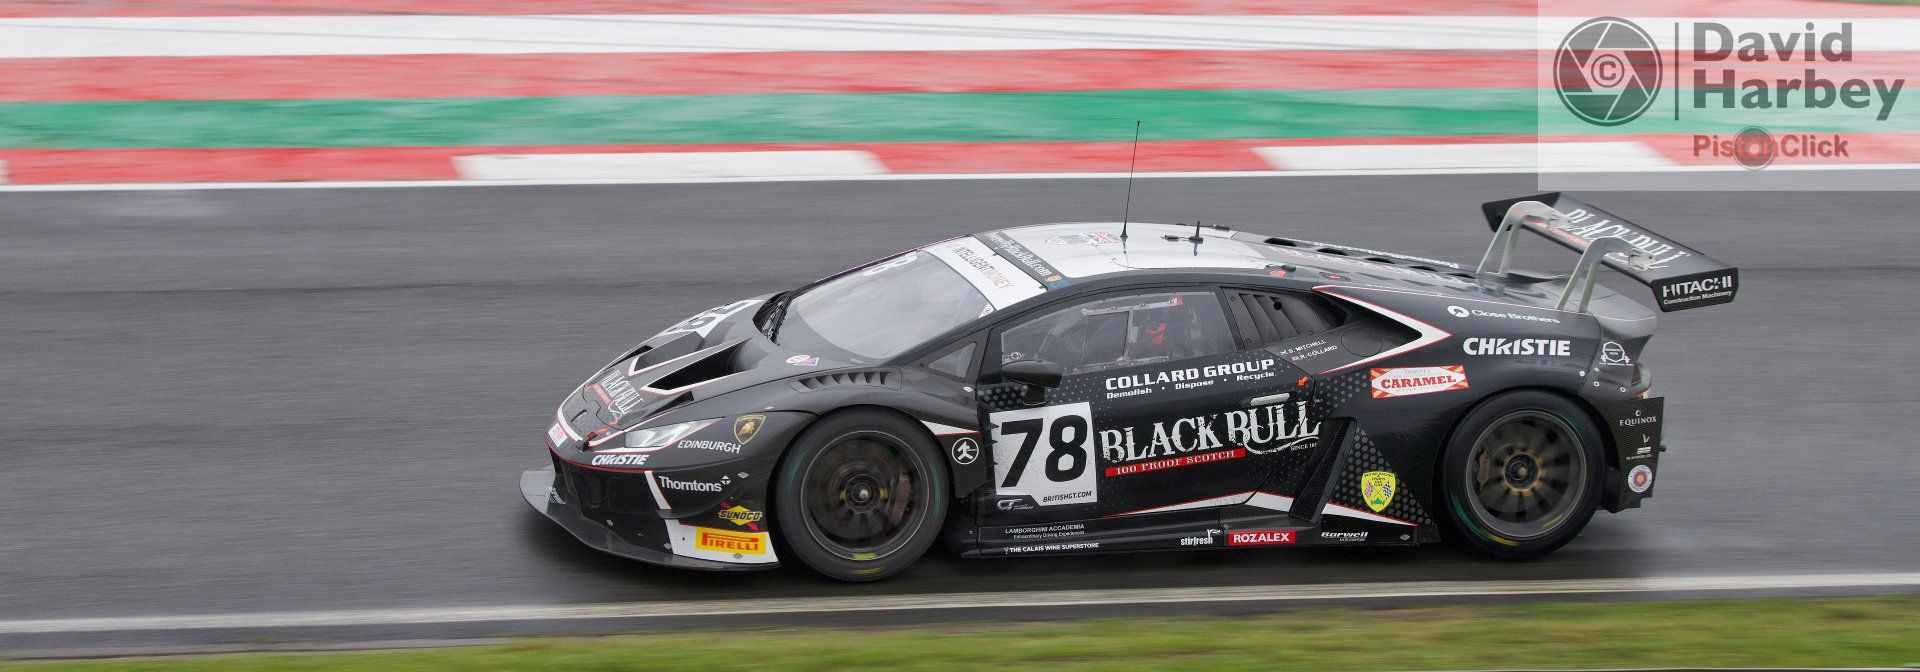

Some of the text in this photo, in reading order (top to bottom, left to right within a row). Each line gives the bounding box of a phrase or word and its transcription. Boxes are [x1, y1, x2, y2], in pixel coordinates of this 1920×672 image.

[1662, 275, 1732, 298] HITACHI
[1663, 290, 1732, 305] Construction Machinery
[1472, 309, 1560, 324] Close Brothers
[1295, 339, 1327, 352] MITCHELL
[1307, 345, 1338, 358] COLLARD
[1463, 338, 1570, 356] CHRISTIE
[1105, 358, 1274, 391] COLLARD GROUP
[1106, 371, 1275, 400] Demolish Dispose Recycle
[1381, 375, 1456, 389] CARAMEL
[1619, 415, 1657, 427] EQUINOX
[1099, 400, 1322, 464] BLACK BULL
[677, 440, 742, 454] EDINBURGH
[1001, 415, 1088, 488] 78
[591, 454, 650, 465] CHRISTIE
[1117, 450, 1235, 476] 100 PROOF SCOTCH
[659, 475, 722, 492] Thorntons
[1043, 491, 1092, 503] BRITISHGT.COM
[720, 510, 760, 521] SUNOCO
[1005, 526, 1048, 534] LAMBORGHINI
[1321, 531, 1369, 539] Barwell
[702, 532, 759, 551] PIRELLI
[1180, 530, 1213, 546] stirfresh
[1233, 532, 1290, 544] ROZALEX
[1061, 542, 1100, 550] SUPERSTORE
